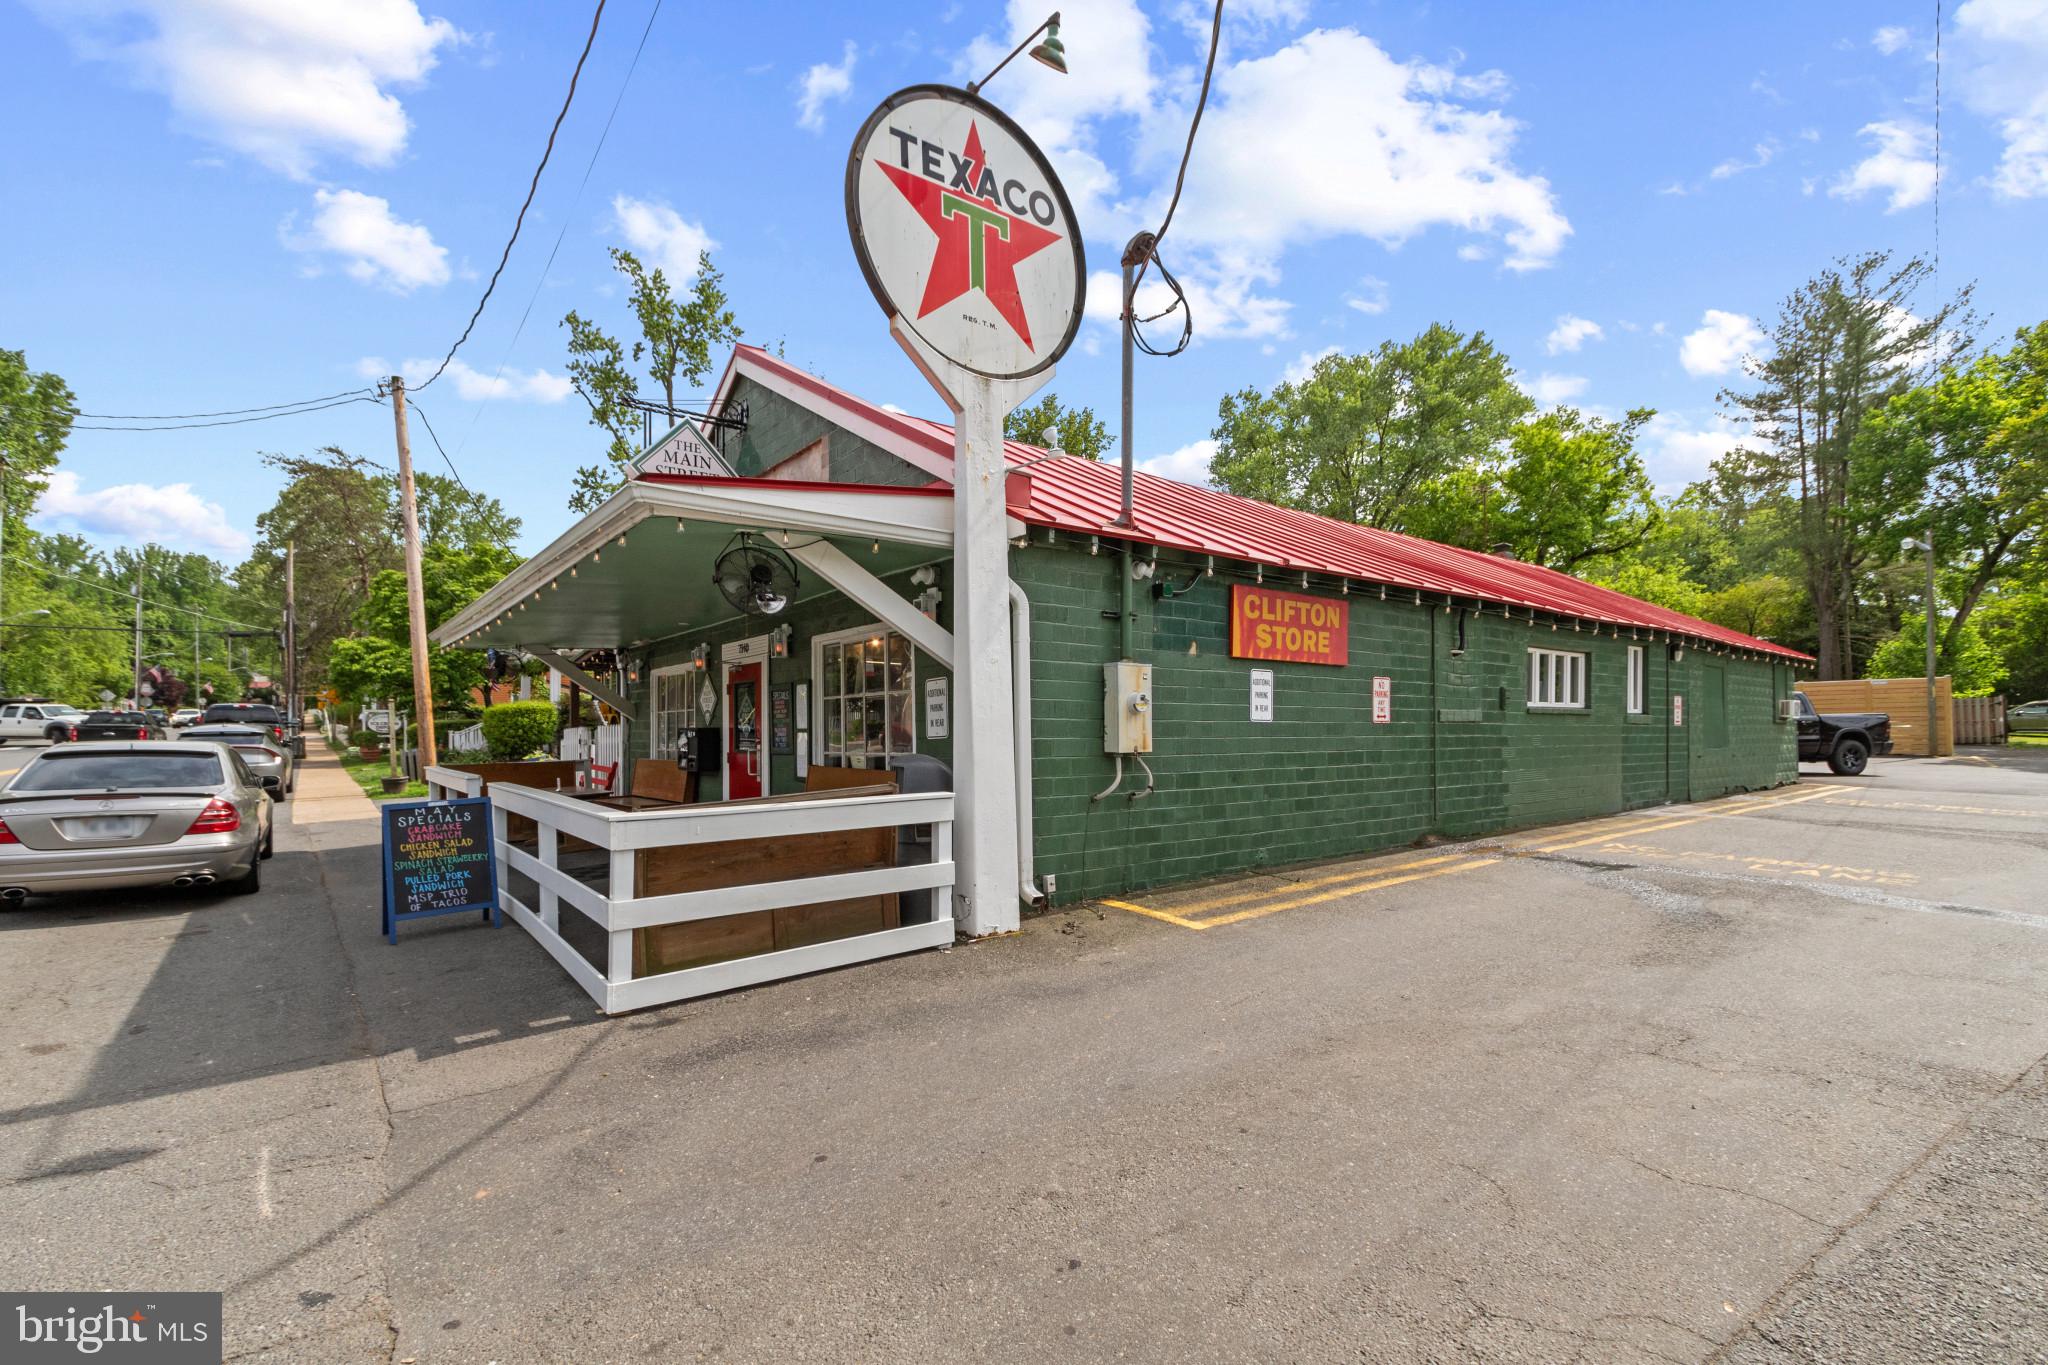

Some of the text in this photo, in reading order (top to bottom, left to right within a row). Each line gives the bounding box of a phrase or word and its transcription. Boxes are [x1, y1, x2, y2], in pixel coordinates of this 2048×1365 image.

[889, 126, 1056, 226] TEXACO
[942, 192, 1010, 293] T
[674, 440, 702, 454] THE
[664, 449, 711, 470] MAIN
[655, 464, 720, 477] STR
[1243, 594, 1340, 629] CLIFTON
[1255, 624, 1330, 653] STORE
[1379, 681, 1385, 689] NO
[930, 703, 944, 712] PARKING
[415, 806, 456, 816] MAY
[398, 812, 471, 828] SPECIALS
[408, 822, 463, 835] CRABCAKE
[400, 837, 473, 852] CHICKEN SALAD
[408, 831, 462, 843] SANDWICH
[409, 848, 458, 860] SANDWICH
[394, 853, 488, 871] SPINACH STRAWBERRY
[419, 864, 455, 875] SALAD
[405, 870, 472, 885] PULLED PORK
[411, 880, 465, 894] SANDWICH
[408, 888, 468, 903] MSP TRIO
[410, 897, 468, 912] OF TACOS
